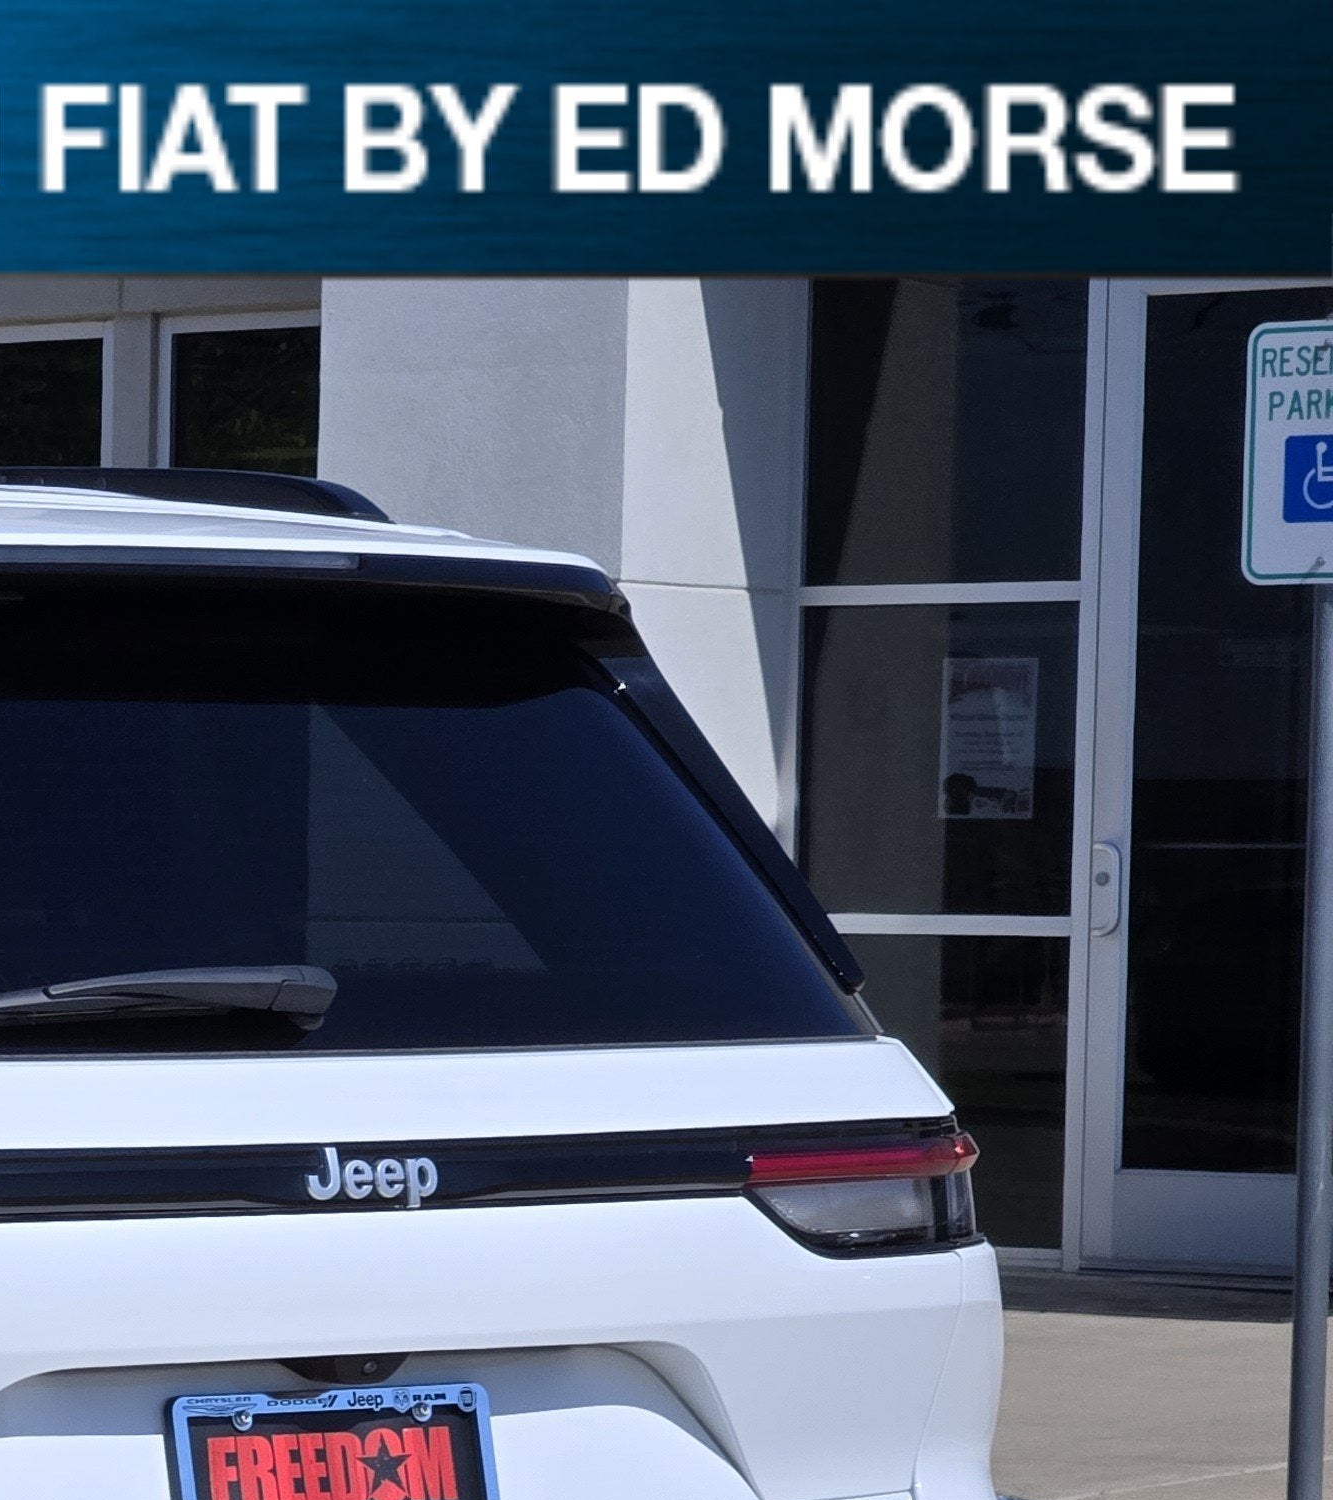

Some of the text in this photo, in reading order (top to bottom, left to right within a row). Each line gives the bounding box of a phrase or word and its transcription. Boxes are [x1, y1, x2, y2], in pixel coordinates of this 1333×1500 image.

[306, 1146, 439, 1209] Jeep
[186, 1391, 447, 1409] CHRYSLER DODGE Jeep RAM
